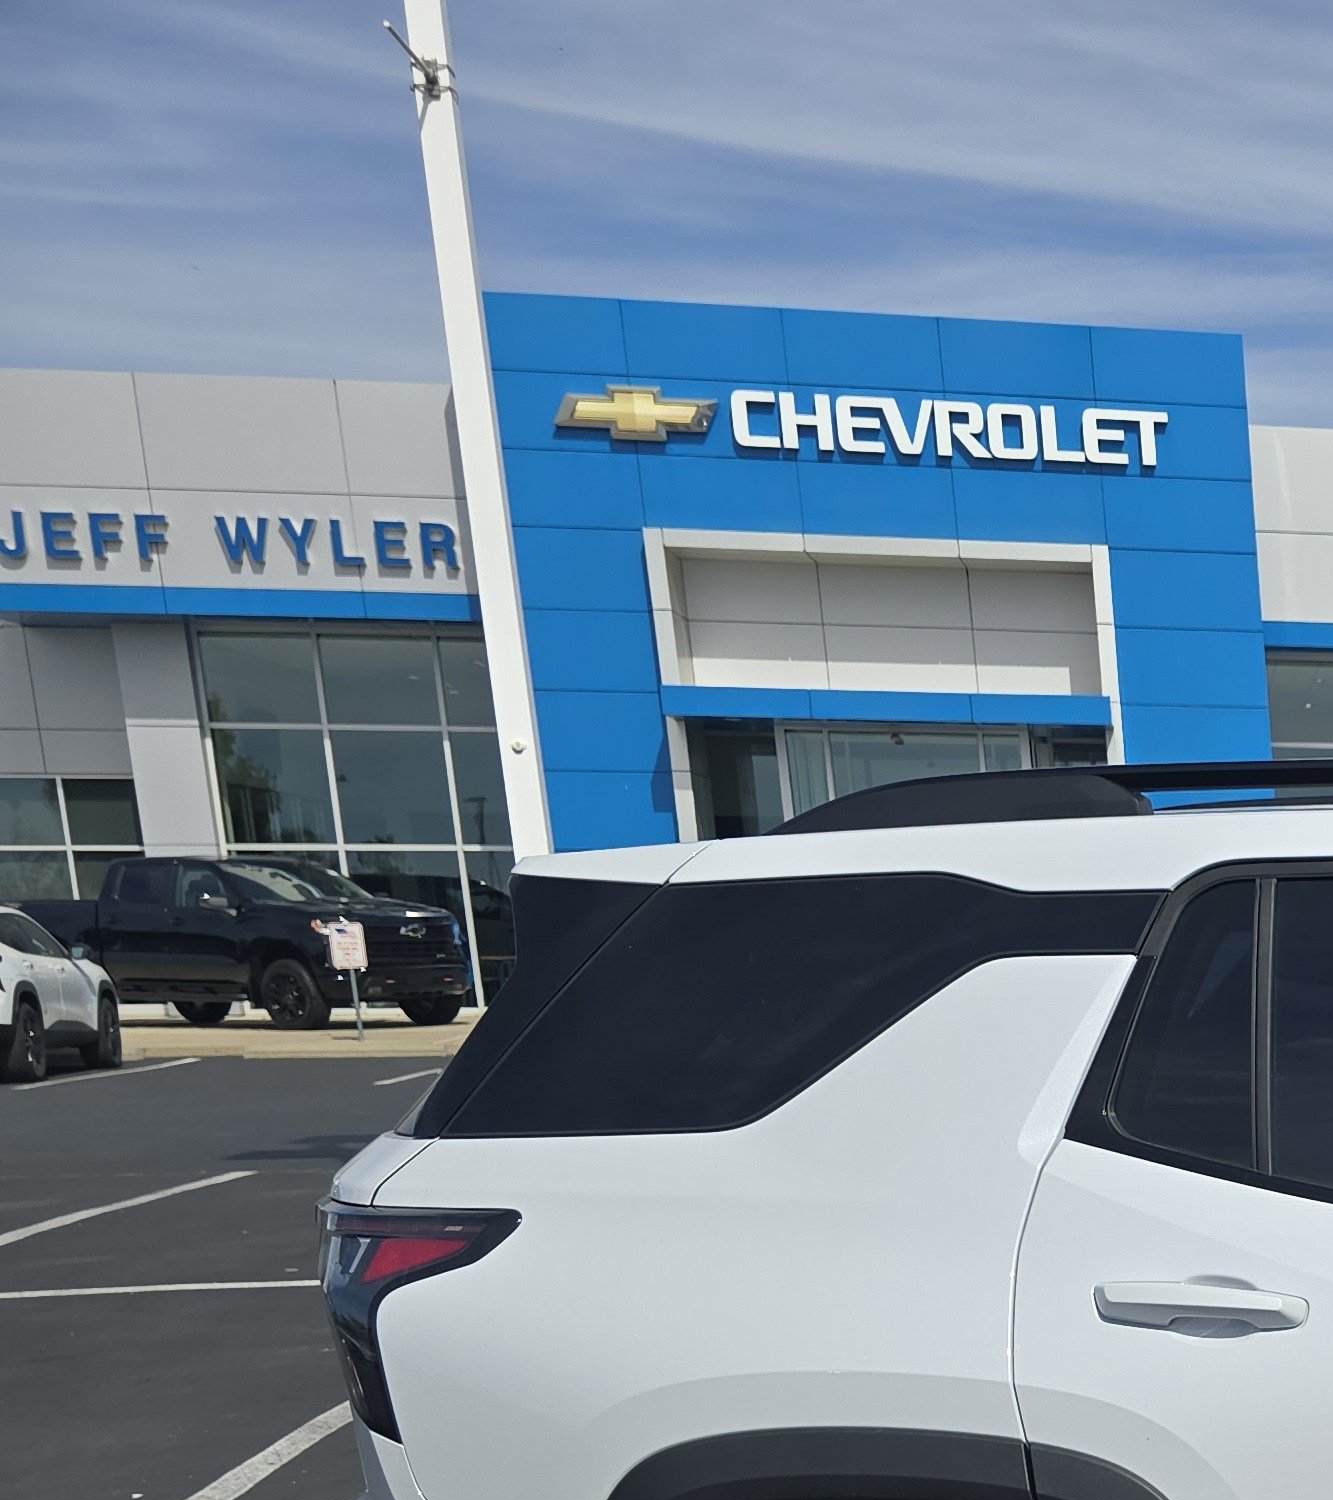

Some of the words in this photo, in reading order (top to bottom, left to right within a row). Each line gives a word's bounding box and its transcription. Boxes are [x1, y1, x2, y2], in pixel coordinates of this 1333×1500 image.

[731, 389, 1168, 466] CHEVROLET
[0, 510, 168, 560] JEFF
[214, 515, 460, 570] WYLER
